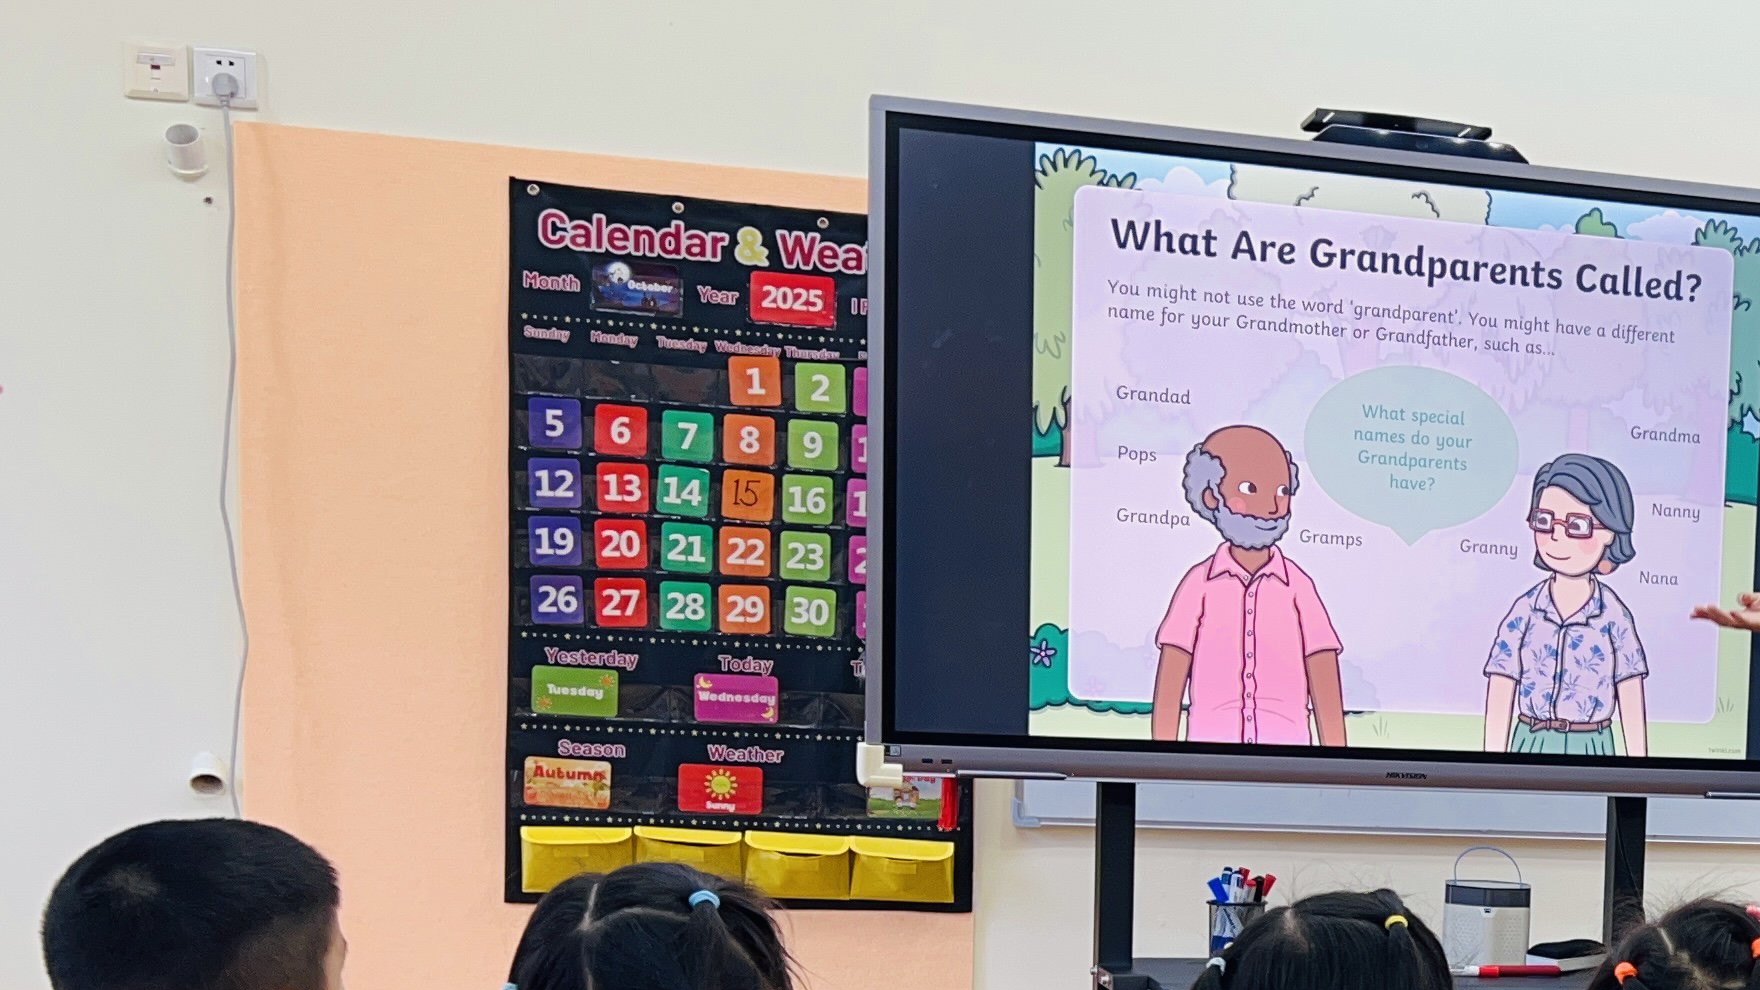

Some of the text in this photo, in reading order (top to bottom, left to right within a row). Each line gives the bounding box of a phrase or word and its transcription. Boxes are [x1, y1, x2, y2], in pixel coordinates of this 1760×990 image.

[538, 209, 867, 274] Calendar & Wea
[1111, 218, 1702, 302] What Are Grandparents Called?
[522, 271, 581, 293] Month
[628, 279, 673, 294] October
[697, 285, 739, 305] Year
[761, 285, 824, 313] 2025
[1107, 280, 1139, 297] You
[1147, 284, 1197, 304] might
[1203, 290, 1230, 304] not
[1237, 293, 1264, 307] use
[1270, 294, 1296, 310] the
[1302, 299, 1343, 315] word
[1469, 312, 1498, 328] You
[1504, 315, 1550, 335] might
[1555, 319, 1591, 337] have
[1596, 325, 1606, 337] a
[1612, 325, 1675, 344] different
[1107, 305, 1556, 356] name for your Grandmother or Grandfather, such as...
[523, 327, 570, 343] Sunday
[590, 332, 638, 348] Monday
[656, 335, 708, 354] Tuesday
[714, 340, 781, 359] Wednesday
[784, 345, 840, 360] Thursday
[746, 368, 830, 402] 1 2
[1116, 385, 1191, 405] Grandad
[1362, 404, 1465, 426] What special
[545, 409, 823, 459] 5 6 7 8 9
[1354, 429, 1472, 451] names do your
[1631, 426, 1700, 443] Grandma
[1118, 445, 1157, 464] Pops
[1358, 451, 1468, 472] Grandparents
[535, 469, 826, 514] 12 13 14 15 16
[1390, 475, 1435, 491] have?
[1116, 508, 1190, 529] Grandpa
[1651, 503, 1700, 522] Nanny
[535, 528, 824, 571] 19 20 21 22 23
[1300, 529, 1363, 550] Gramps
[1460, 540, 1518, 560] Granny
[1639, 571, 1678, 586] Nana
[538, 585, 829, 626] 26 27 28 29 30
[544, 647, 639, 671] Yesterday
[718, 655, 774, 676] Today
[547, 683, 604, 700] Tuesday
[698, 690, 776, 706] Wednesday
[558, 740, 626, 758] Season
[707, 744, 784, 764] Weather
[533, 764, 607, 781] Autumn
[706, 801, 736, 813] Sunny
